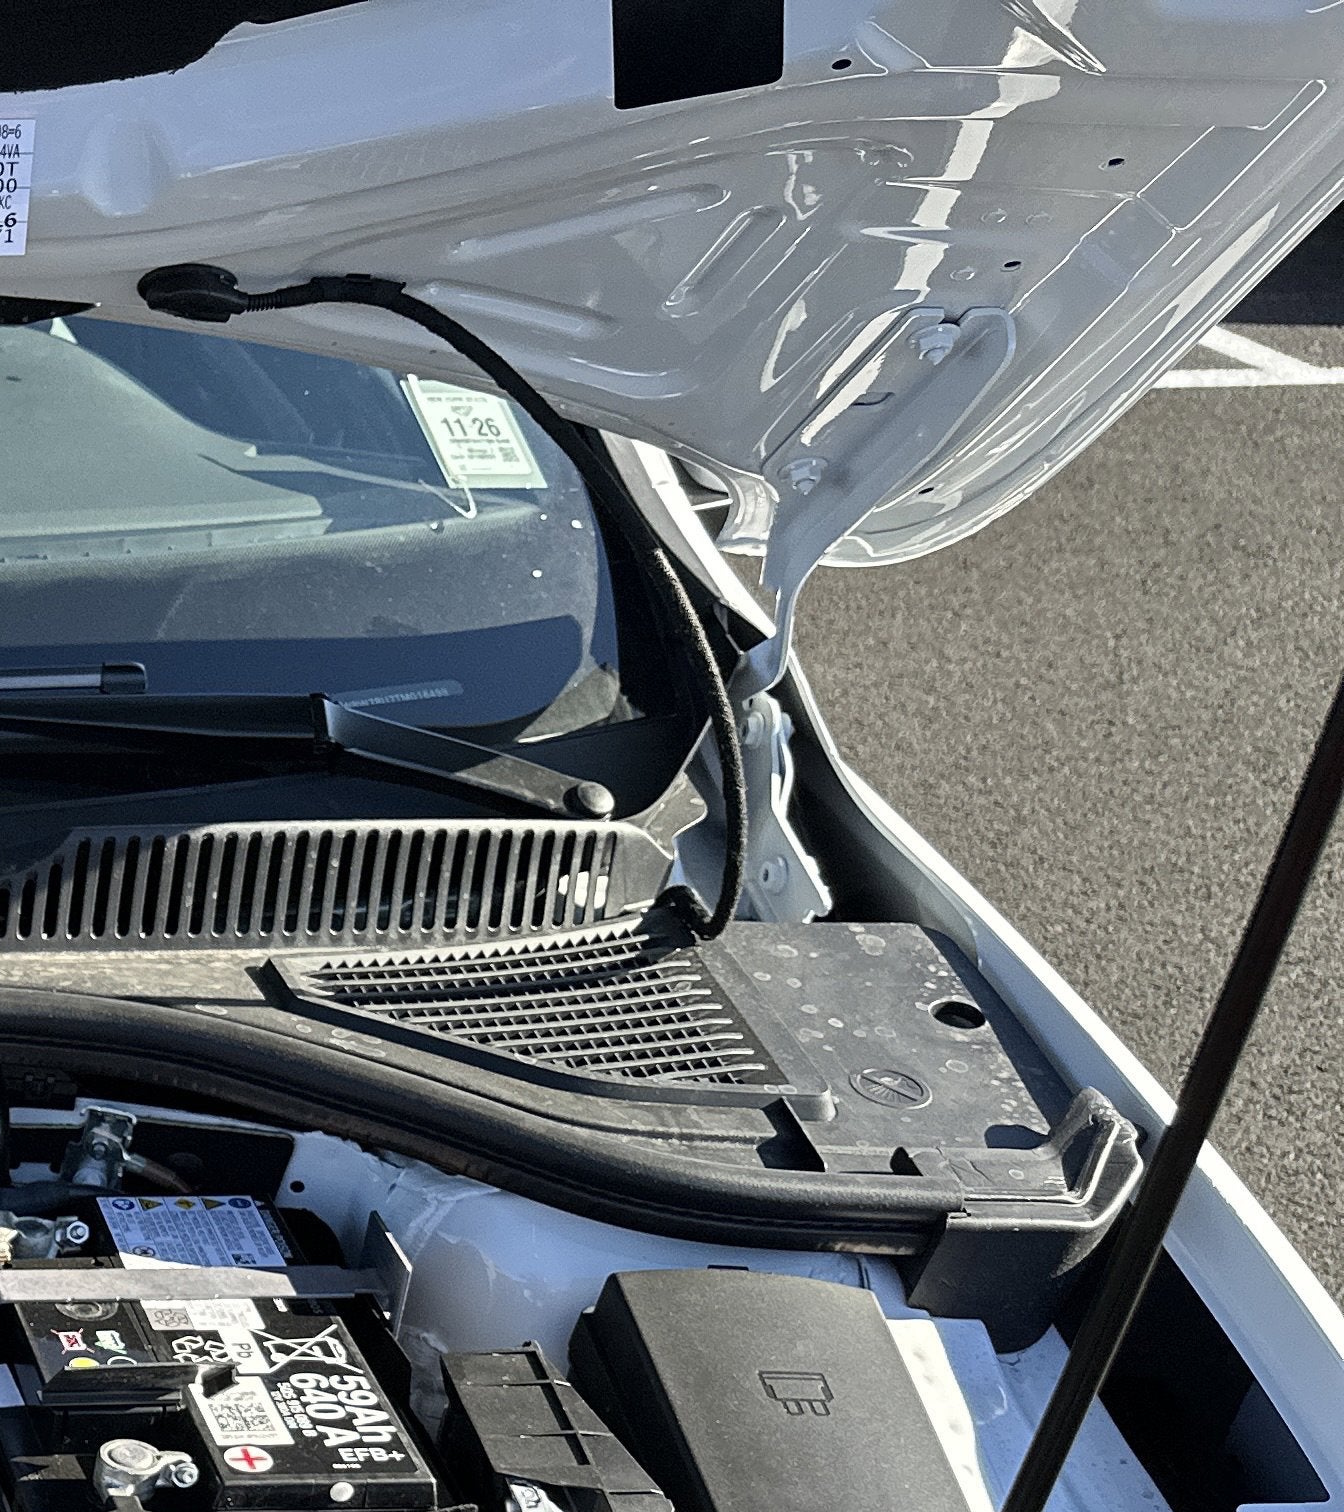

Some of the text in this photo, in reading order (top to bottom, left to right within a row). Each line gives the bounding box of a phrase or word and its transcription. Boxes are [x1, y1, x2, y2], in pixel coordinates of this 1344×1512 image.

[232, 1342, 251, 1358] Pb
[289, 1373, 347, 1420] 640
[329, 1375, 398, 1443] 59Ah
[316, 1425, 361, 1447] A
